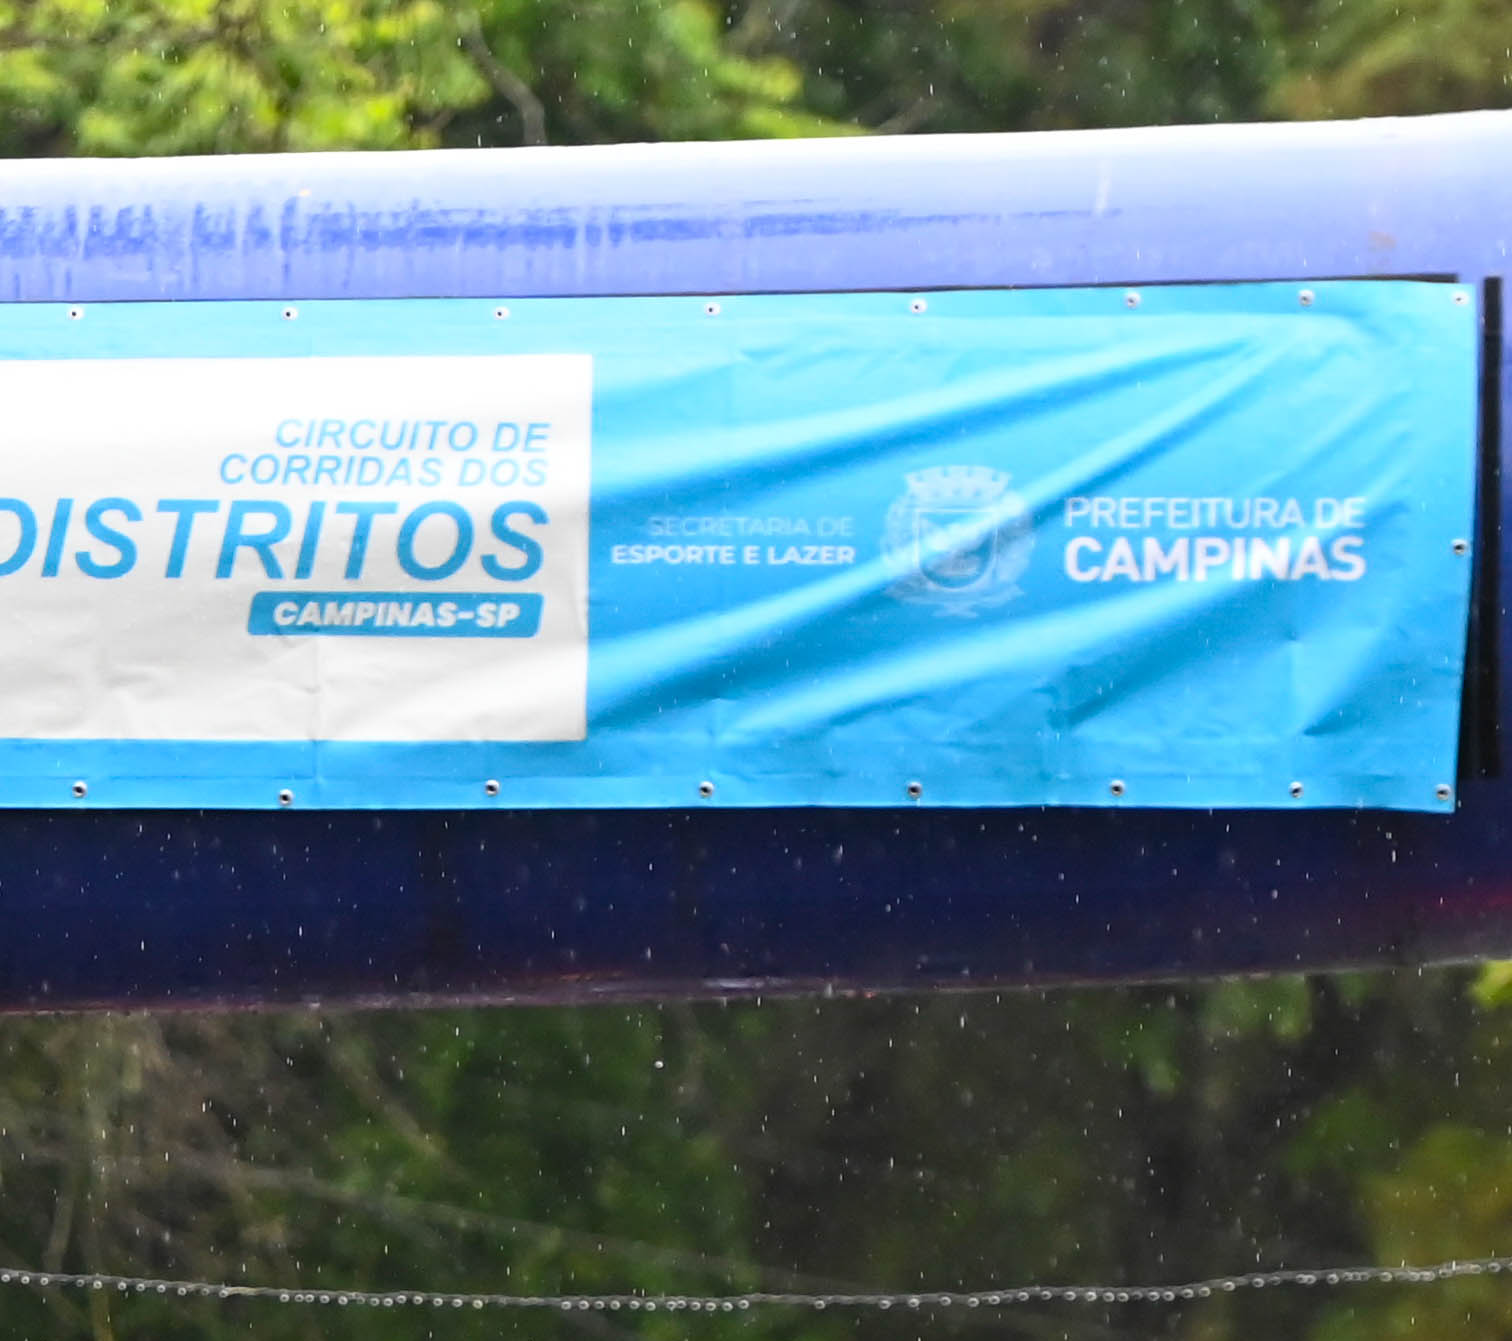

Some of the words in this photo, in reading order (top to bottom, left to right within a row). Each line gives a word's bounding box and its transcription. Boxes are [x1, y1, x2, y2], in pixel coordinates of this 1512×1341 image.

[274, 419, 478, 452] CIRCUITO
[491, 422, 551, 453] DE
[218, 453, 443, 487] CORRIDAS
[456, 458, 548, 487] DOS
[647, 516, 809, 538] SECRETARIA
[815, 517, 854, 537] DE
[1064, 496, 1299, 529] PREFEITURA
[1319, 498, 1365, 529] DE
[611, 545, 736, 565] ESPORTE
[744, 546, 758, 564] E
[767, 545, 855, 565] LAZER
[1064, 536, 1366, 582] CAMPINAS
[271, 601, 520, 627] CAMPINAS-SP
